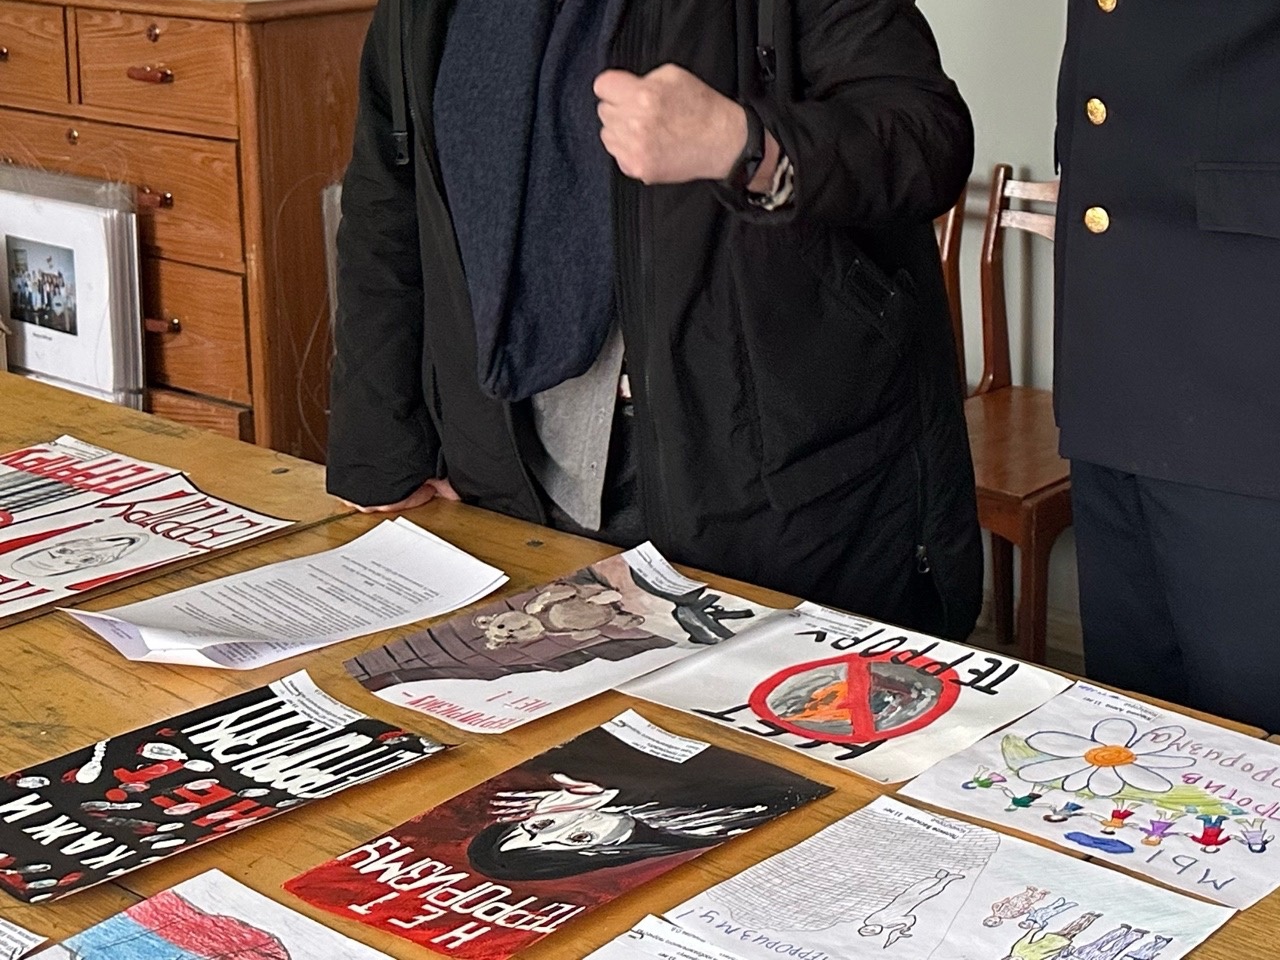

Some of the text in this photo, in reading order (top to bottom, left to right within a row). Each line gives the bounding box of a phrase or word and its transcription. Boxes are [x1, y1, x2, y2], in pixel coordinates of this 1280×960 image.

[405, 695, 524, 730] ТЕРРОРИЗМУ
[691, 704, 888, 761] НЕТ
[337, 836, 586, 934] ТЕРРОРИЗМУ
[348, 892, 491, 949] НЕТ
